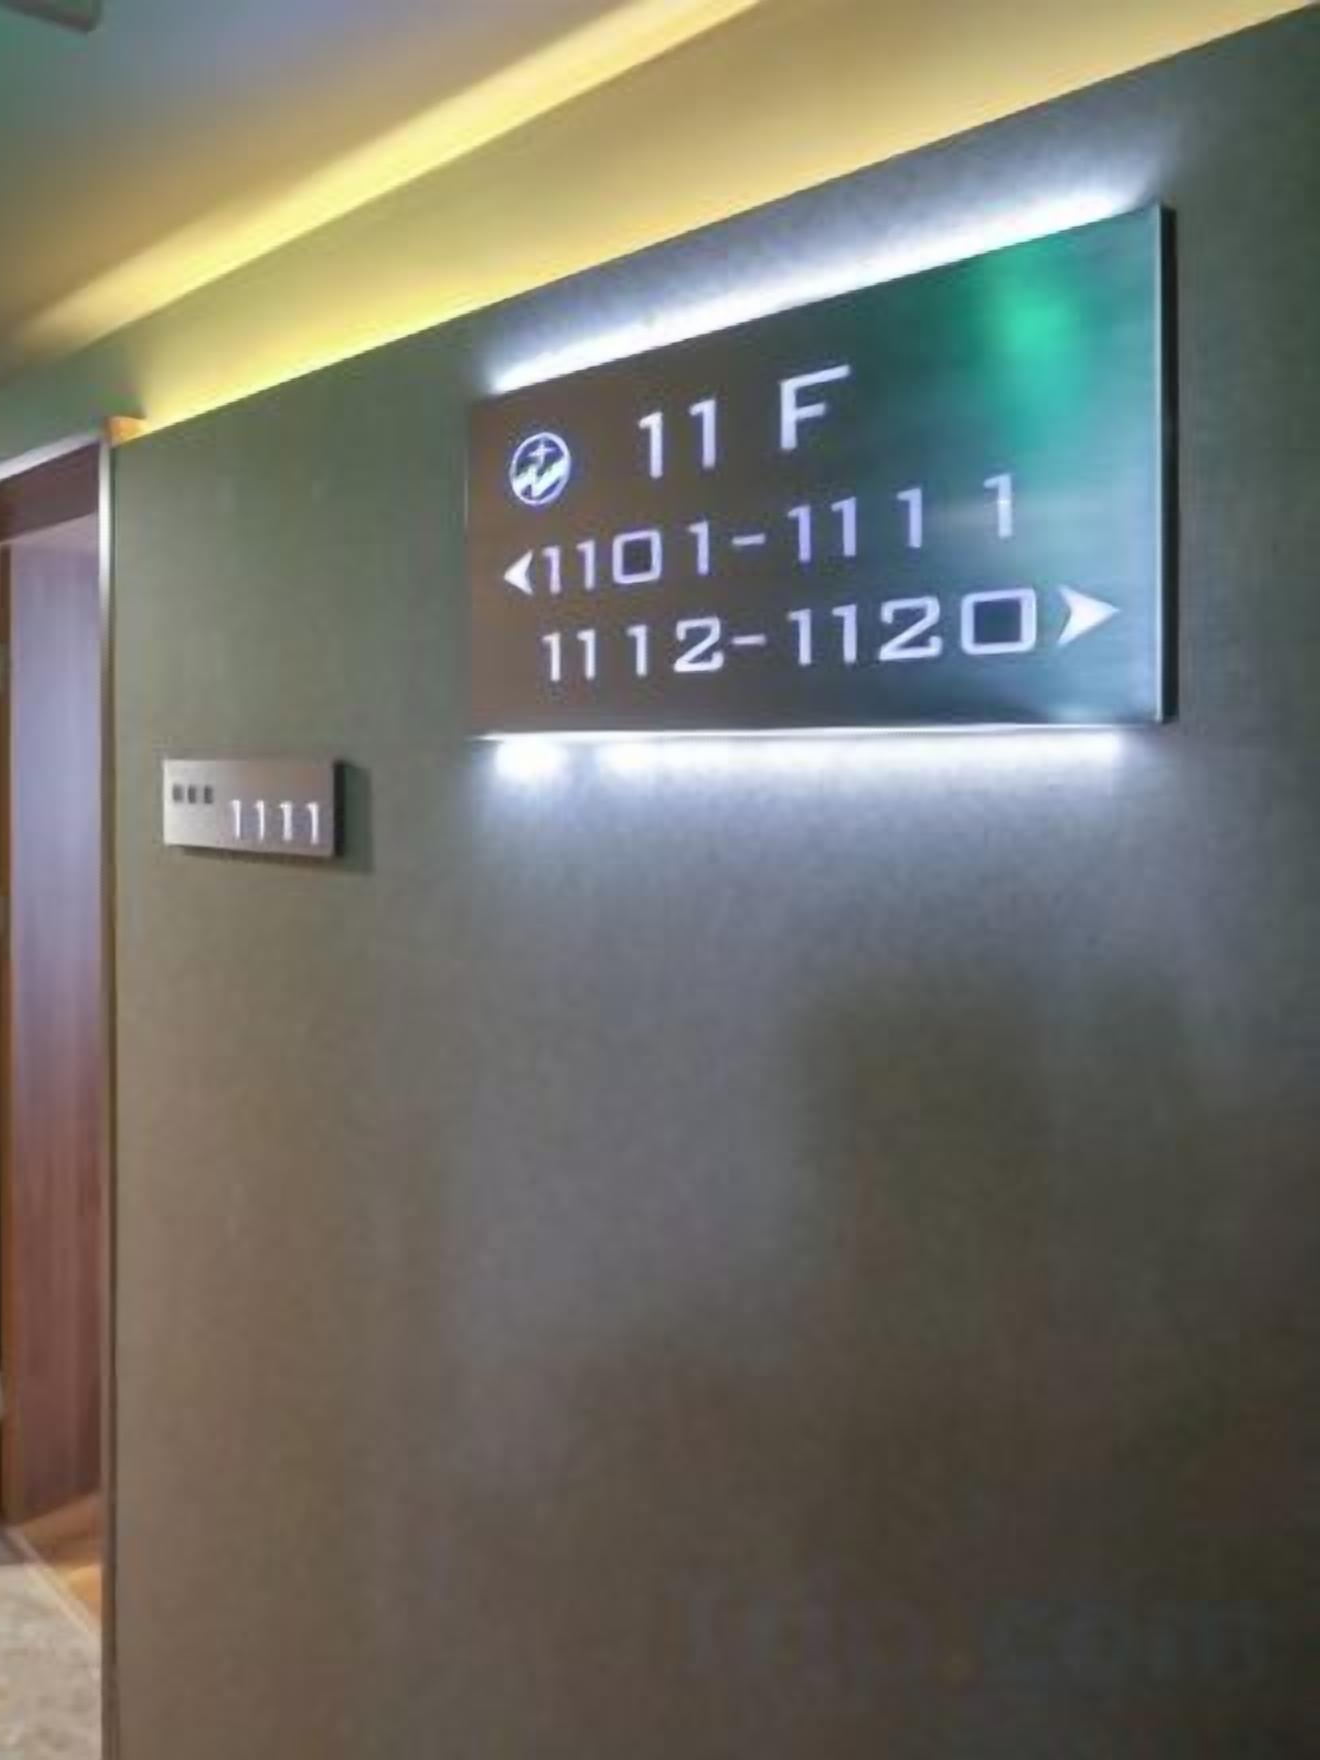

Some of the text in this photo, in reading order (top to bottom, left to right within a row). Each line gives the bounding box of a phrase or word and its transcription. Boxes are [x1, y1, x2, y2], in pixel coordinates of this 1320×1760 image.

[638, 364, 851, 480] 11 F
[231, 799, 320, 846] 1111
